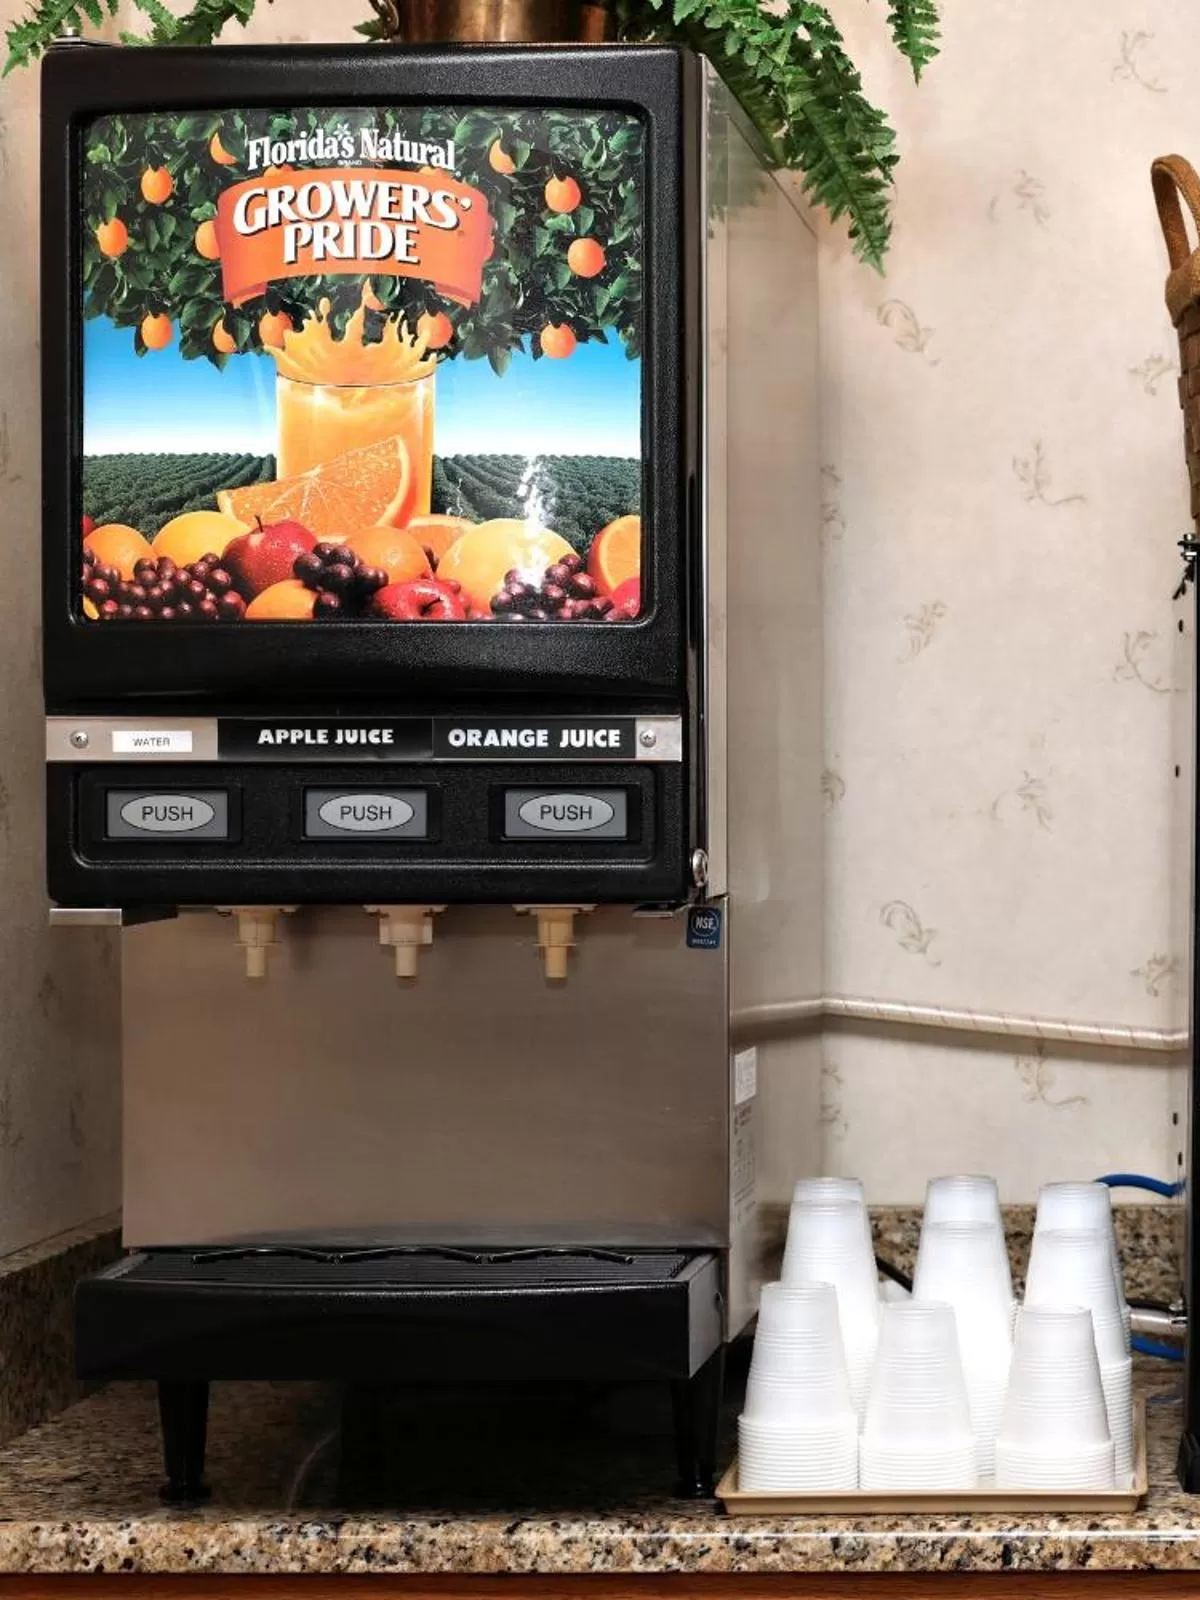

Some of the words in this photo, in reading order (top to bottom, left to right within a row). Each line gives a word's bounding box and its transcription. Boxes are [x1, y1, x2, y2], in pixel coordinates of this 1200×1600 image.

[247, 125, 354, 171] Florida's
[359, 127, 456, 171] Natural
[283, 220, 421, 265] PRIDE
[133, 736, 170, 747] WATER
[257, 728, 328, 745] APPLE
[334, 728, 394, 745] JUICE
[448, 728, 549, 748] ORANGE
[560, 728, 621, 748] JUICE
[141, 805, 194, 821] PUSH
[340, 805, 393, 821] PUSH
[540, 805, 593, 821] PUSH
